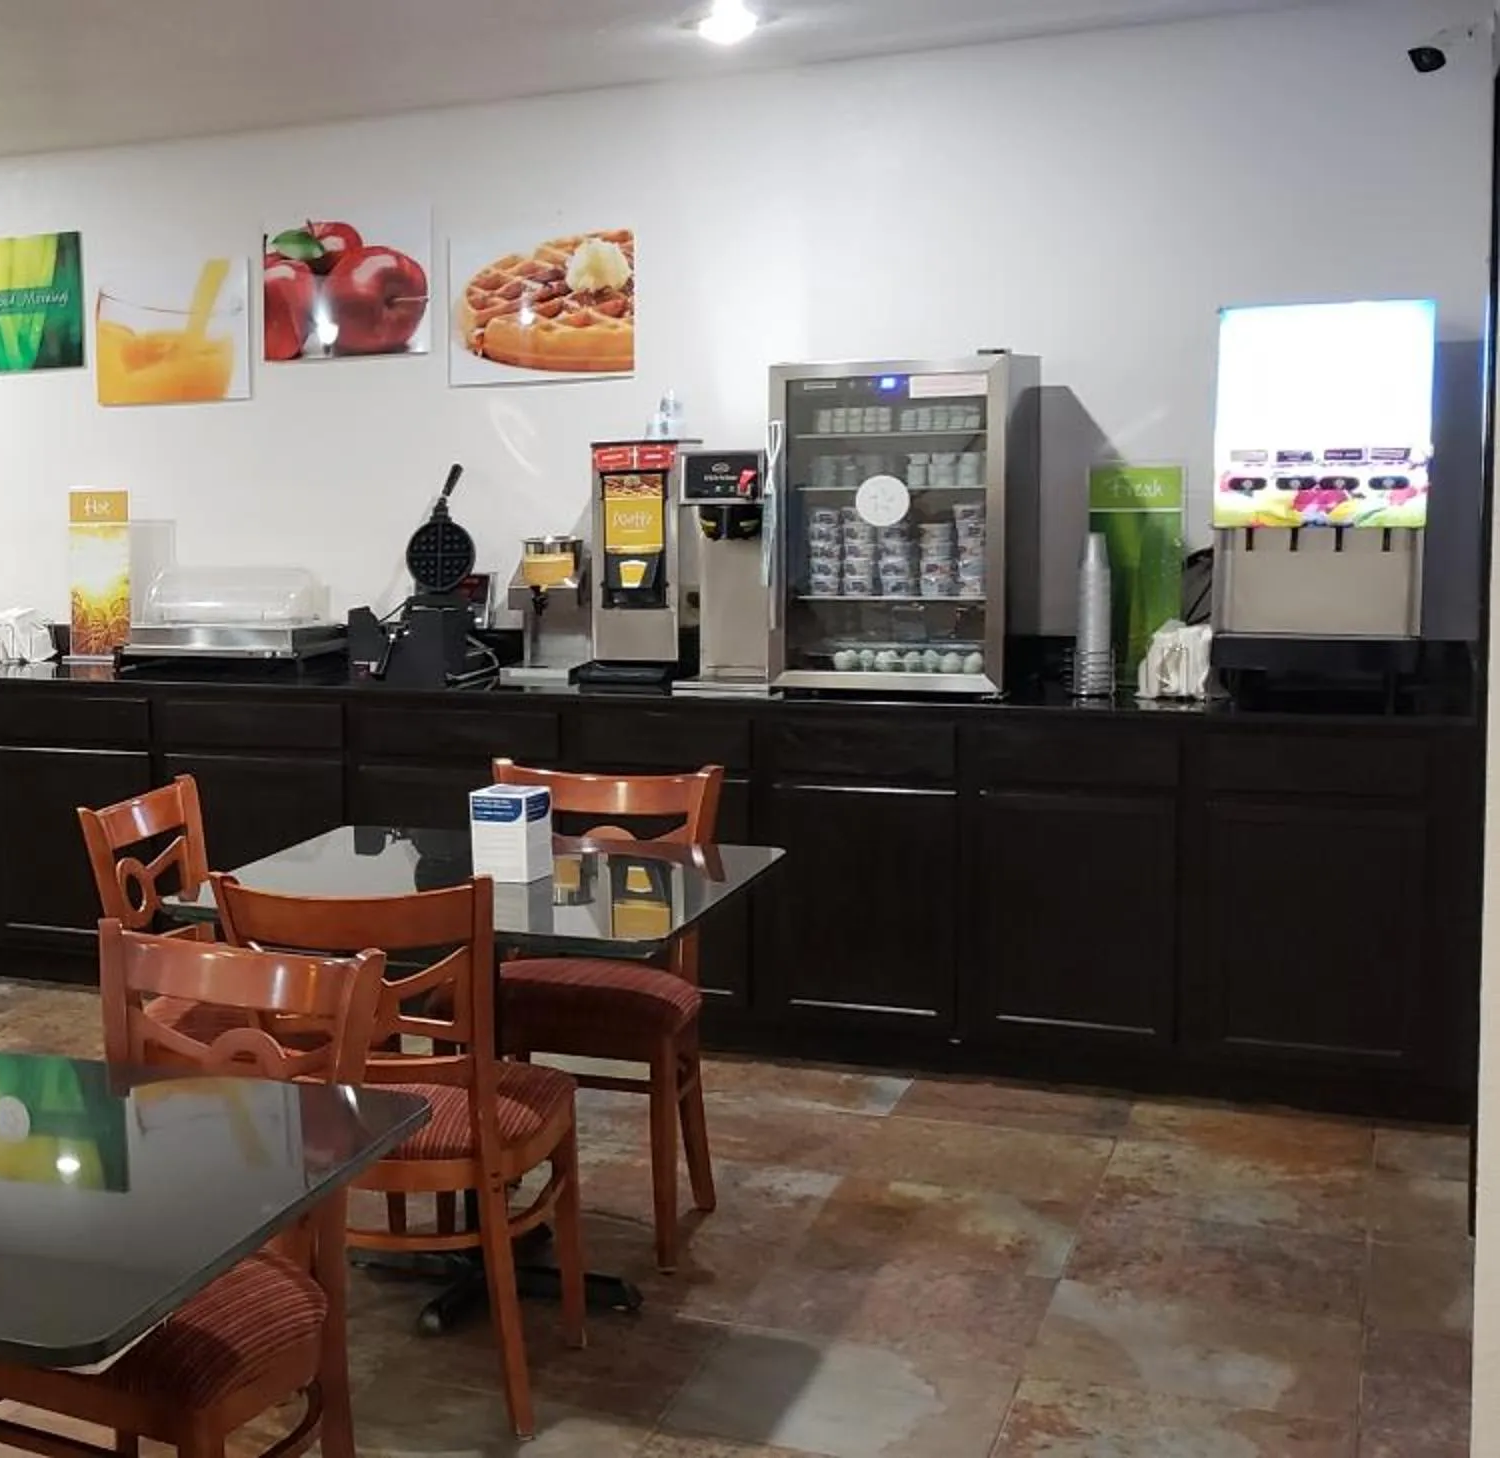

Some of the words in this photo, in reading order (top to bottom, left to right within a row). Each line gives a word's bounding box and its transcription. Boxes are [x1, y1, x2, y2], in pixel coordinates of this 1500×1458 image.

[17, 289, 69, 308] Morning
[1105, 475, 1164, 497] Fresh
[84, 495, 113, 517] Hot
